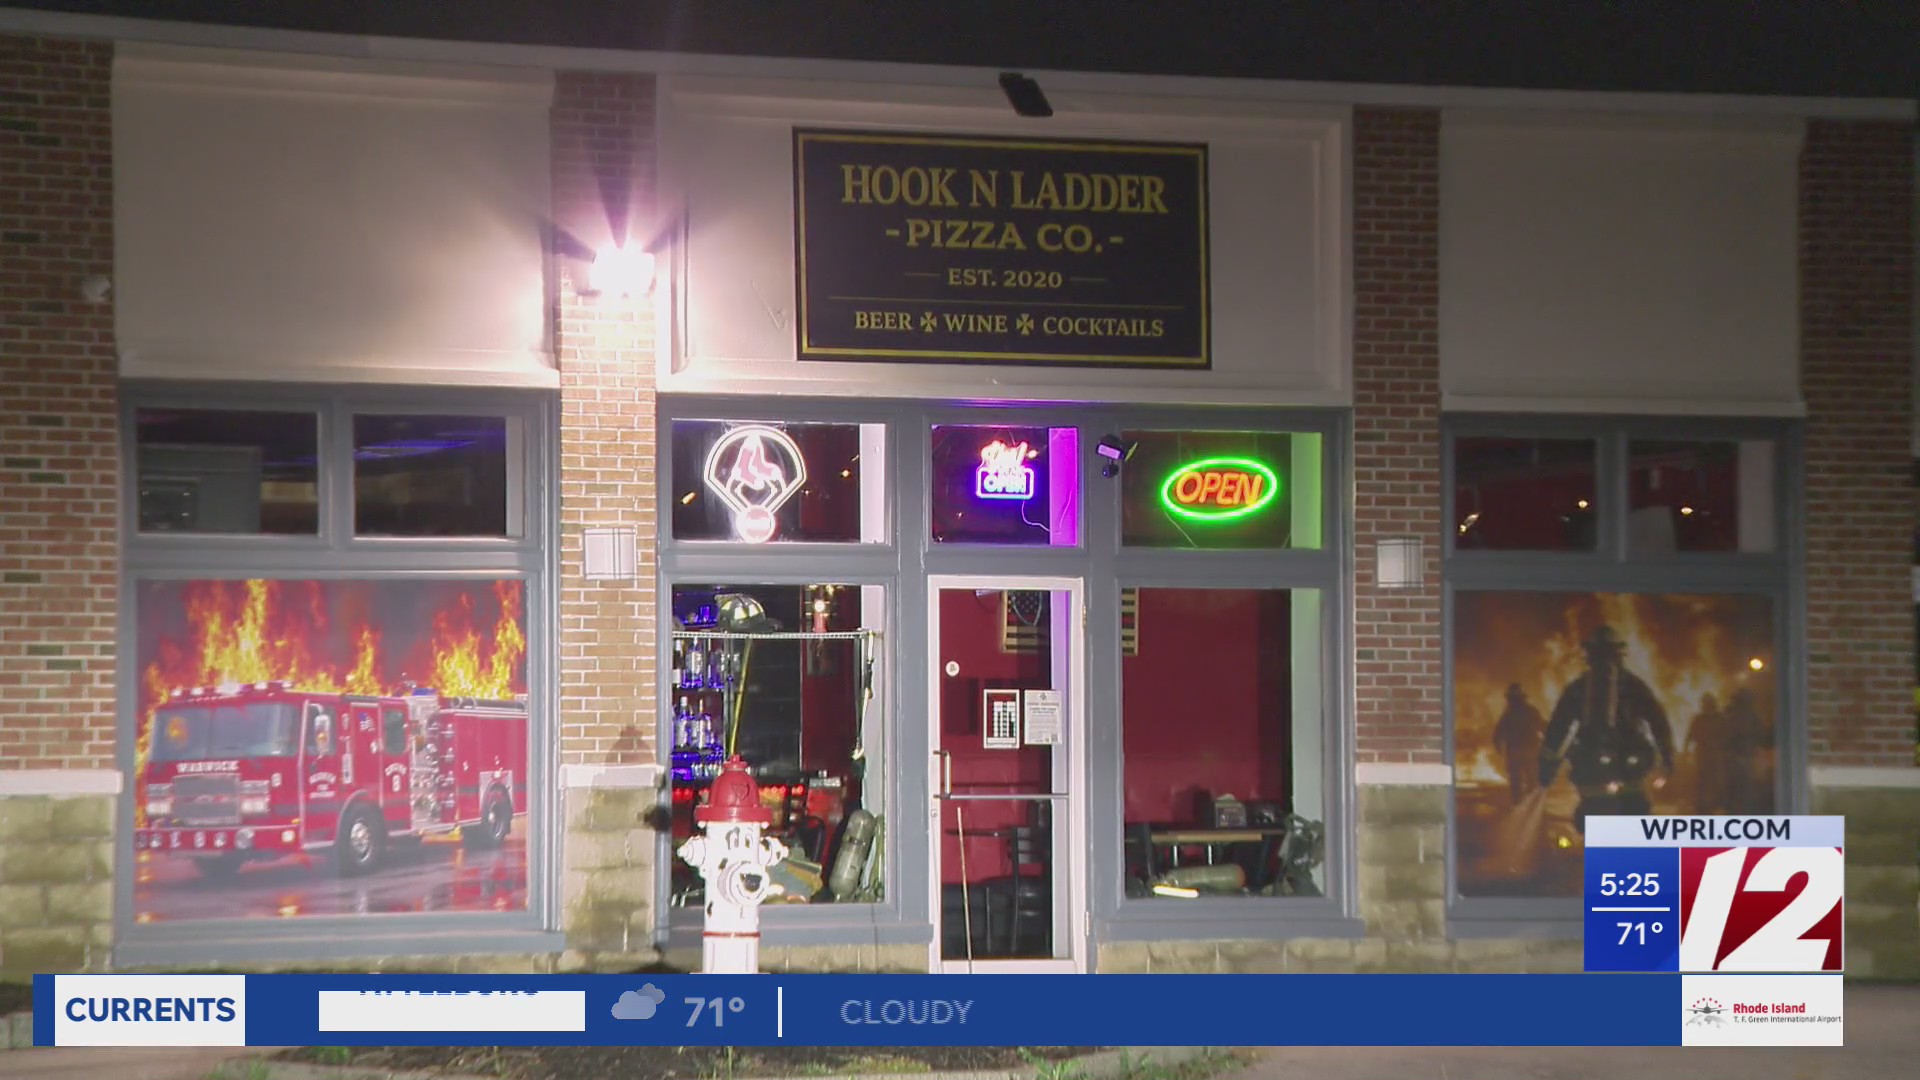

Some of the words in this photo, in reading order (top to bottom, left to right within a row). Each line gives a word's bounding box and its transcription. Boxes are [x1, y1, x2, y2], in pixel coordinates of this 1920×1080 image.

[841, 164, 959, 206] HOOK
[969, 169, 998, 208] N
[1010, 170, 1169, 214] LADDER
[948, 268, 997, 286] EST.
[1003, 270, 1063, 289] 2020
[855, 311, 913, 331] BEER
[943, 313, 1008, 333] WINE
[1043, 316, 1164, 337] COCKTAILS
[1176, 471, 1262, 505] OPEN
